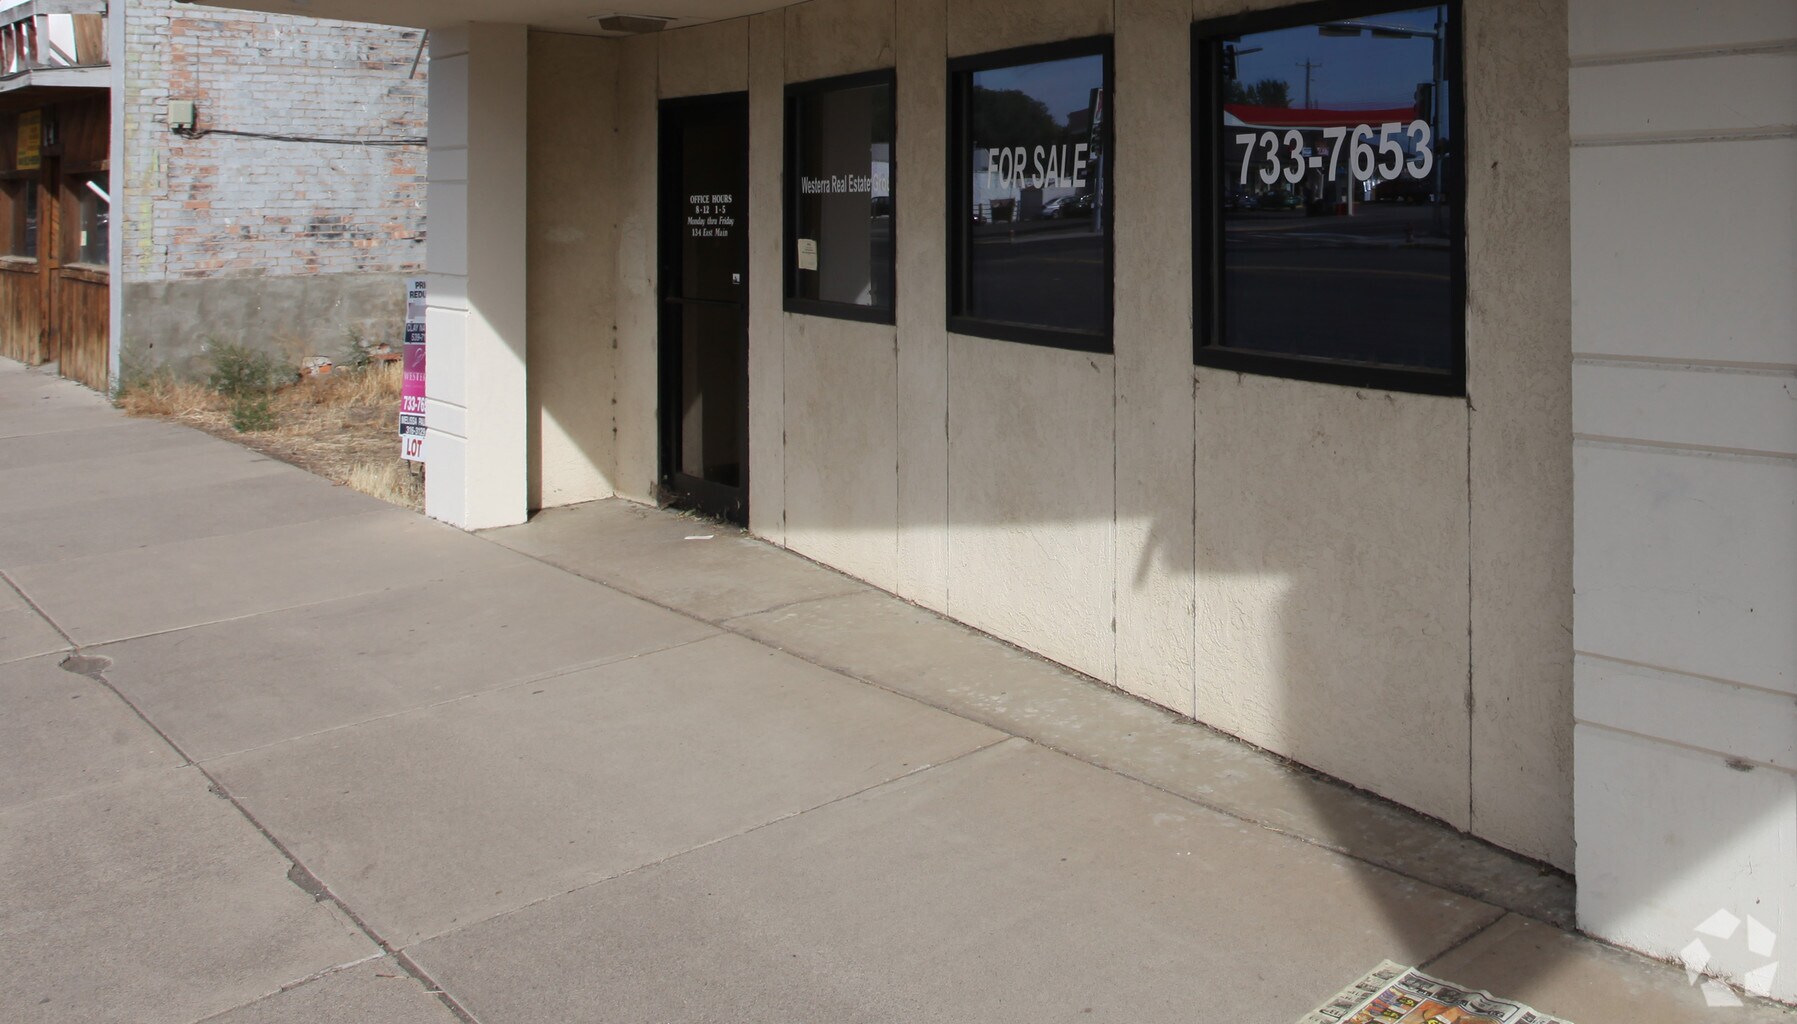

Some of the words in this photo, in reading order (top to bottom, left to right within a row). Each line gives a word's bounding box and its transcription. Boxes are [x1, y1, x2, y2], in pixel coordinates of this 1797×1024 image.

[1235, 119, 1433, 185] 733-7653
[987, 146, 1027, 189] FOR
[1032, 143, 1088, 189] SALE
[801, 177, 830, 194] Westerra
[832, 174, 847, 193] Real
[848, 174, 871, 193] Estate
[690, 195, 710, 204] OFFICE
[711, 194, 733, 203] HOURS
[687, 216, 706, 227] Monday
[707, 216, 718, 225] thru
[718, 216, 735, 227] Friday
[702, 228, 713, 237] East
[714, 228, 729, 237] Main
[407, 438, 422, 457] LOT
